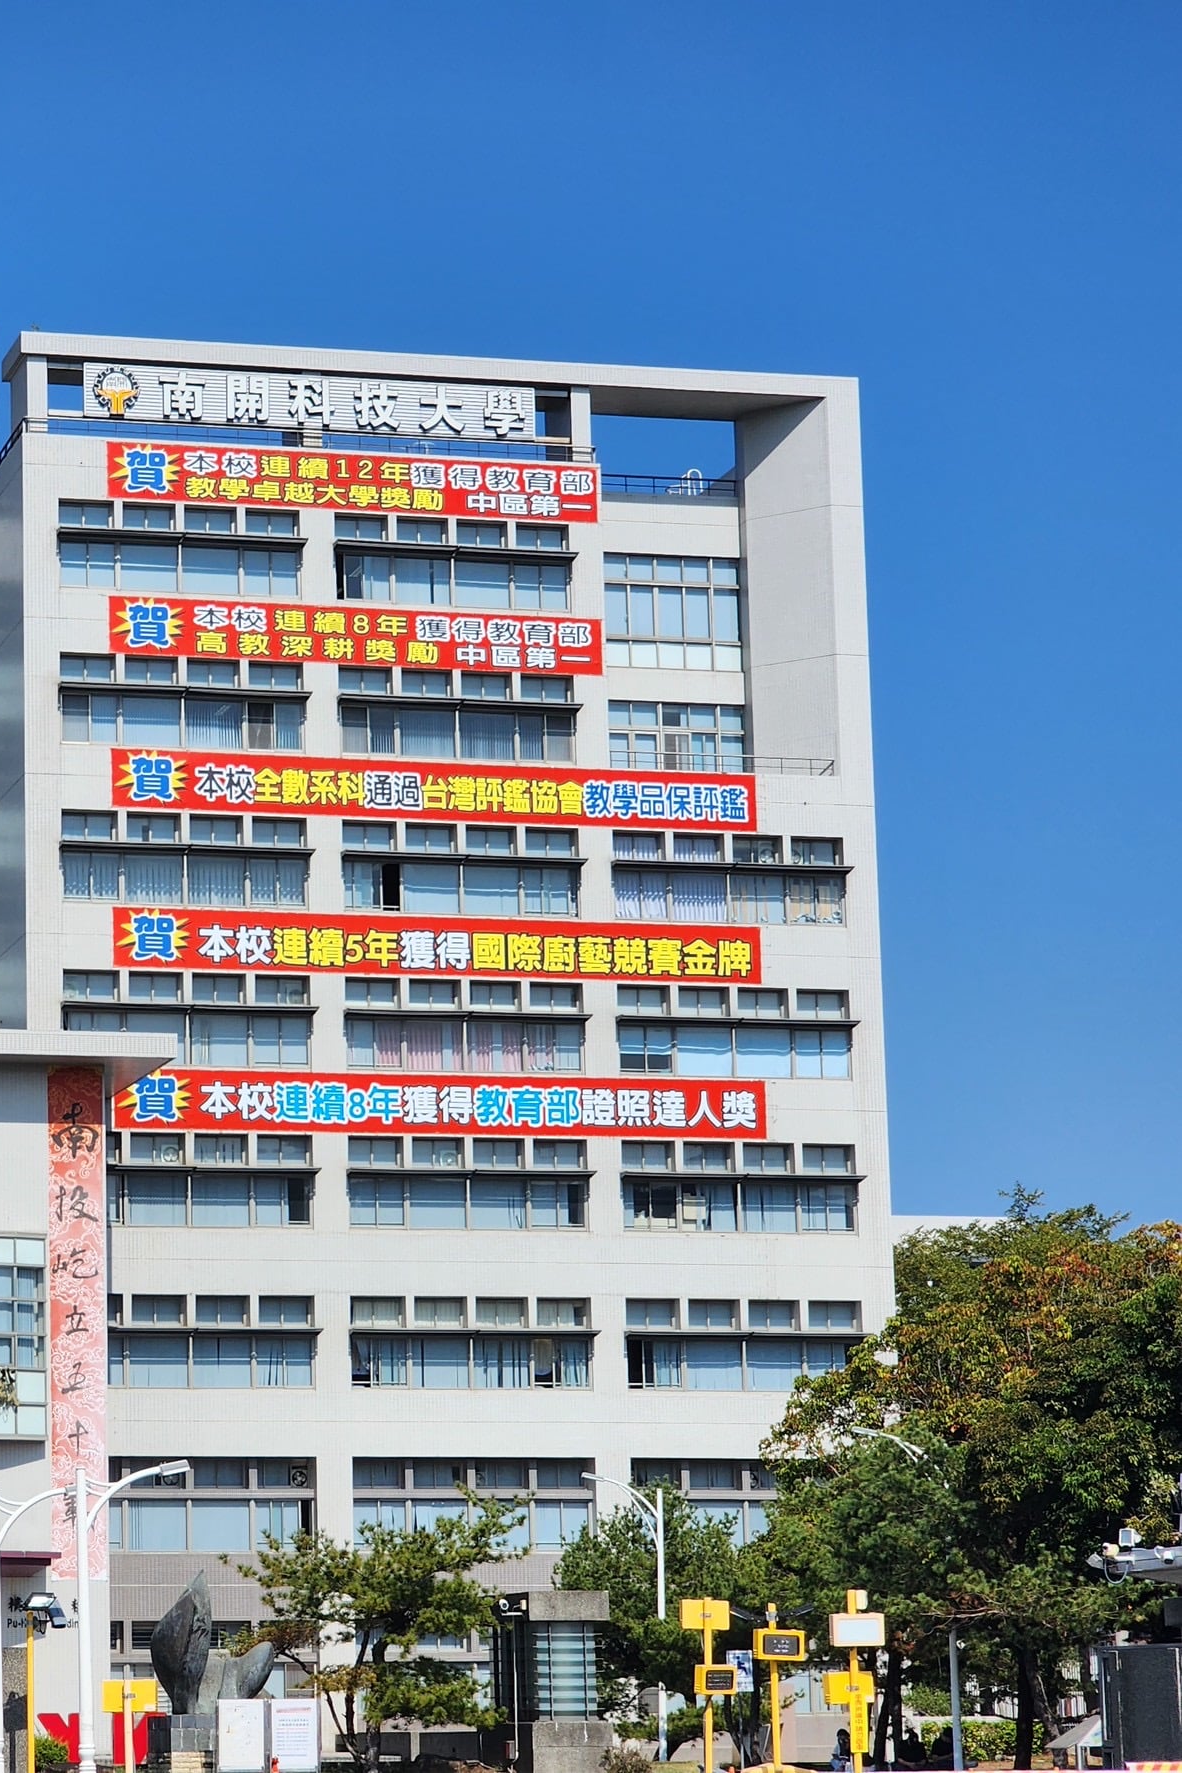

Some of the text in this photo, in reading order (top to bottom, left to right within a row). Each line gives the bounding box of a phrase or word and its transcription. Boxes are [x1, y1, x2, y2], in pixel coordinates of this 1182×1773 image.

[158, 371, 527, 437] 南開科技大學
[125, 449, 168, 494] 賀
[185, 476, 593, 517] 教學卓越大學獎勵 中區第一
[128, 604, 170, 648] 賀
[130, 756, 175, 801] 賀
[132, 914, 753, 977] 賀 本校連續5年獲得國際廚藝競賽金牌
[134, 1075, 758, 1129] 賀 本校連續8年獲得教育部證照達人獎
